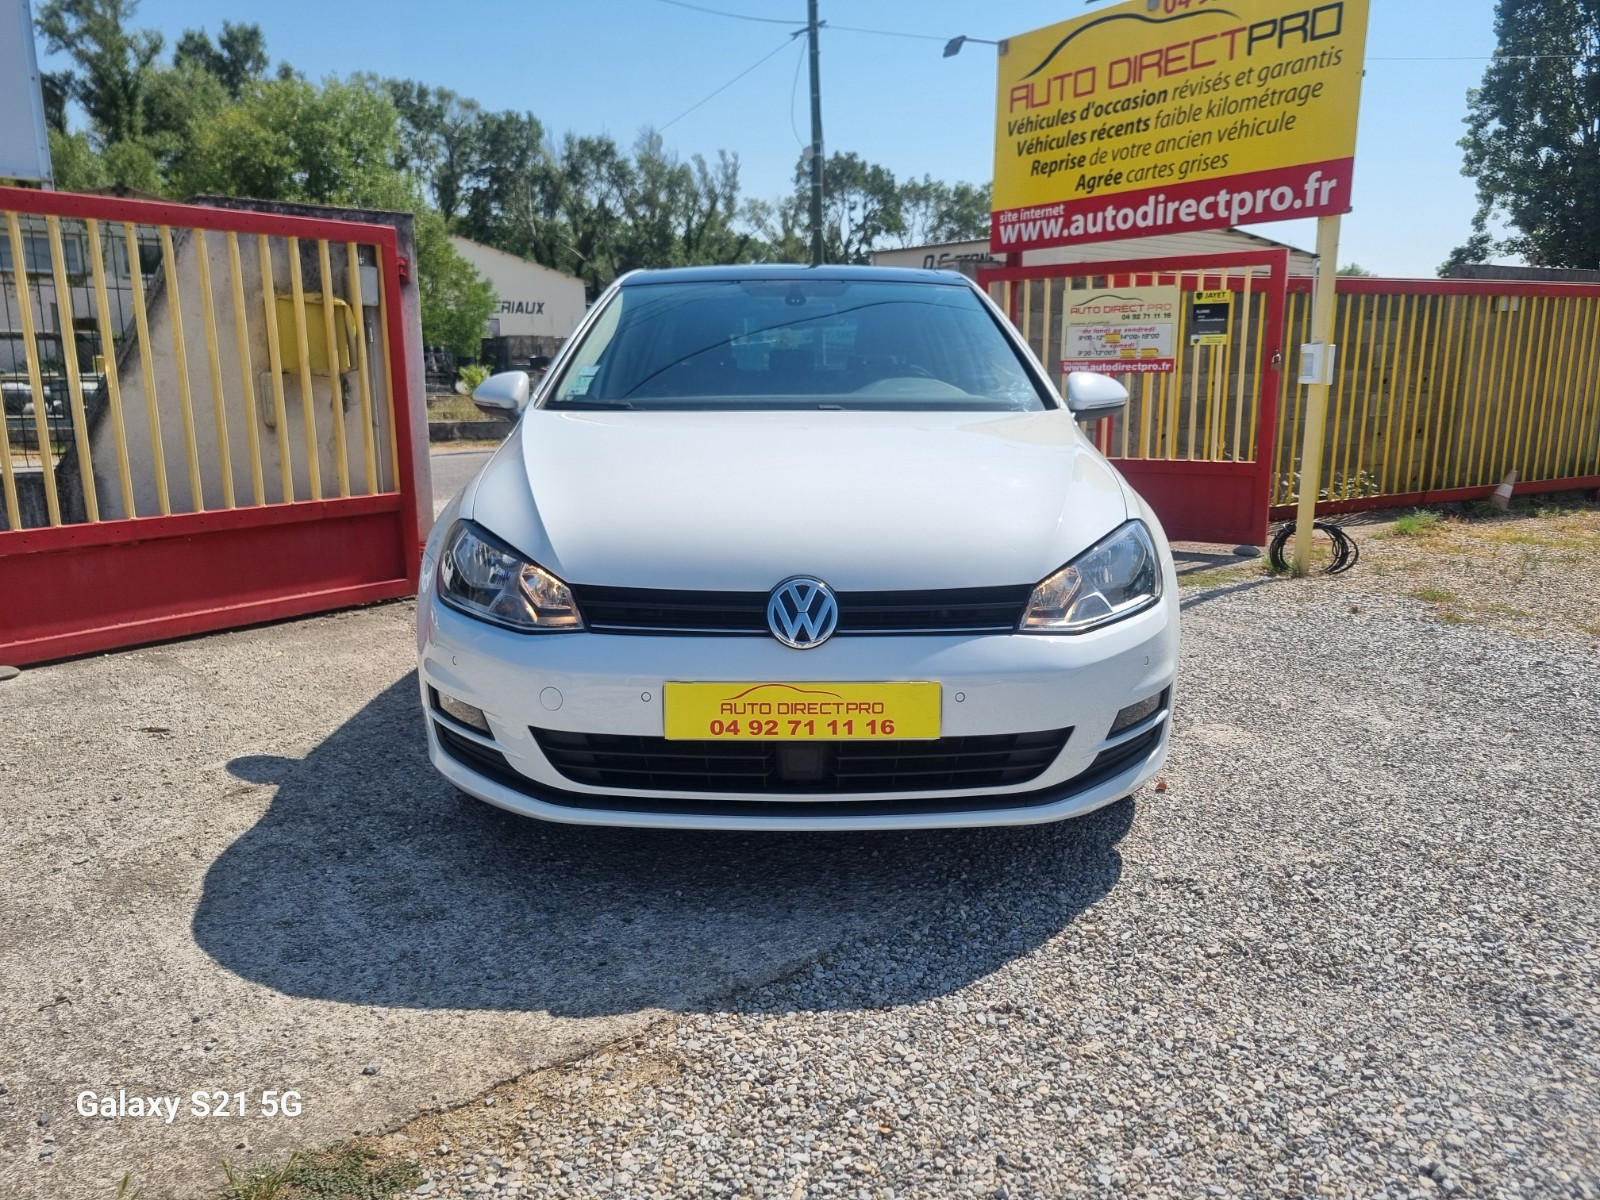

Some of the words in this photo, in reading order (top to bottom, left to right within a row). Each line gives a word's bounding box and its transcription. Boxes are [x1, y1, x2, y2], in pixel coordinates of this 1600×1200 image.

[1007, 109, 1076, 137] Véhicules
[1080, 89, 1168, 122] d'occasion
[1172, 71, 1232, 101] révisés
[1235, 67, 1254, 87] et
[1257, 46, 1344, 88] garantis
[1009, 66, 1097, 113] AUTO
[1017, 130, 1087, 157] Véhicules
[1090, 116, 1151, 142] récents
[1154, 104, 1203, 129] faible
[1205, 82, 1324, 120] kilométrage
[1030, 153, 1086, 177] Reprise
[1089, 147, 1108, 166] de
[1111, 142, 1152, 162] votre
[1155, 130, 1212, 155] ancien
[1217, 111, 1297, 143] véhicule
[1075, 169, 1123, 194] Agrée
[1126, 162, 1174, 183] cartes
[1178, 153, 1229, 181] grises
[999, 170, 1338, 245] www.autodirectpro.fr
[999, 211, 1018, 224] site
[1020, 204, 1065, 222] internet
[1070, 305, 1101, 315] AUTO
[1063, 361, 1171, 372] www.autodirectpro.fr
[709, 719, 740, 735] 04
[748, 719, 778, 735] 92
[787, 719, 815, 735] 71
[827, 719, 853, 735] 11
[865, 719, 895, 735] 16
[720, 702, 771, 715] AUTO
